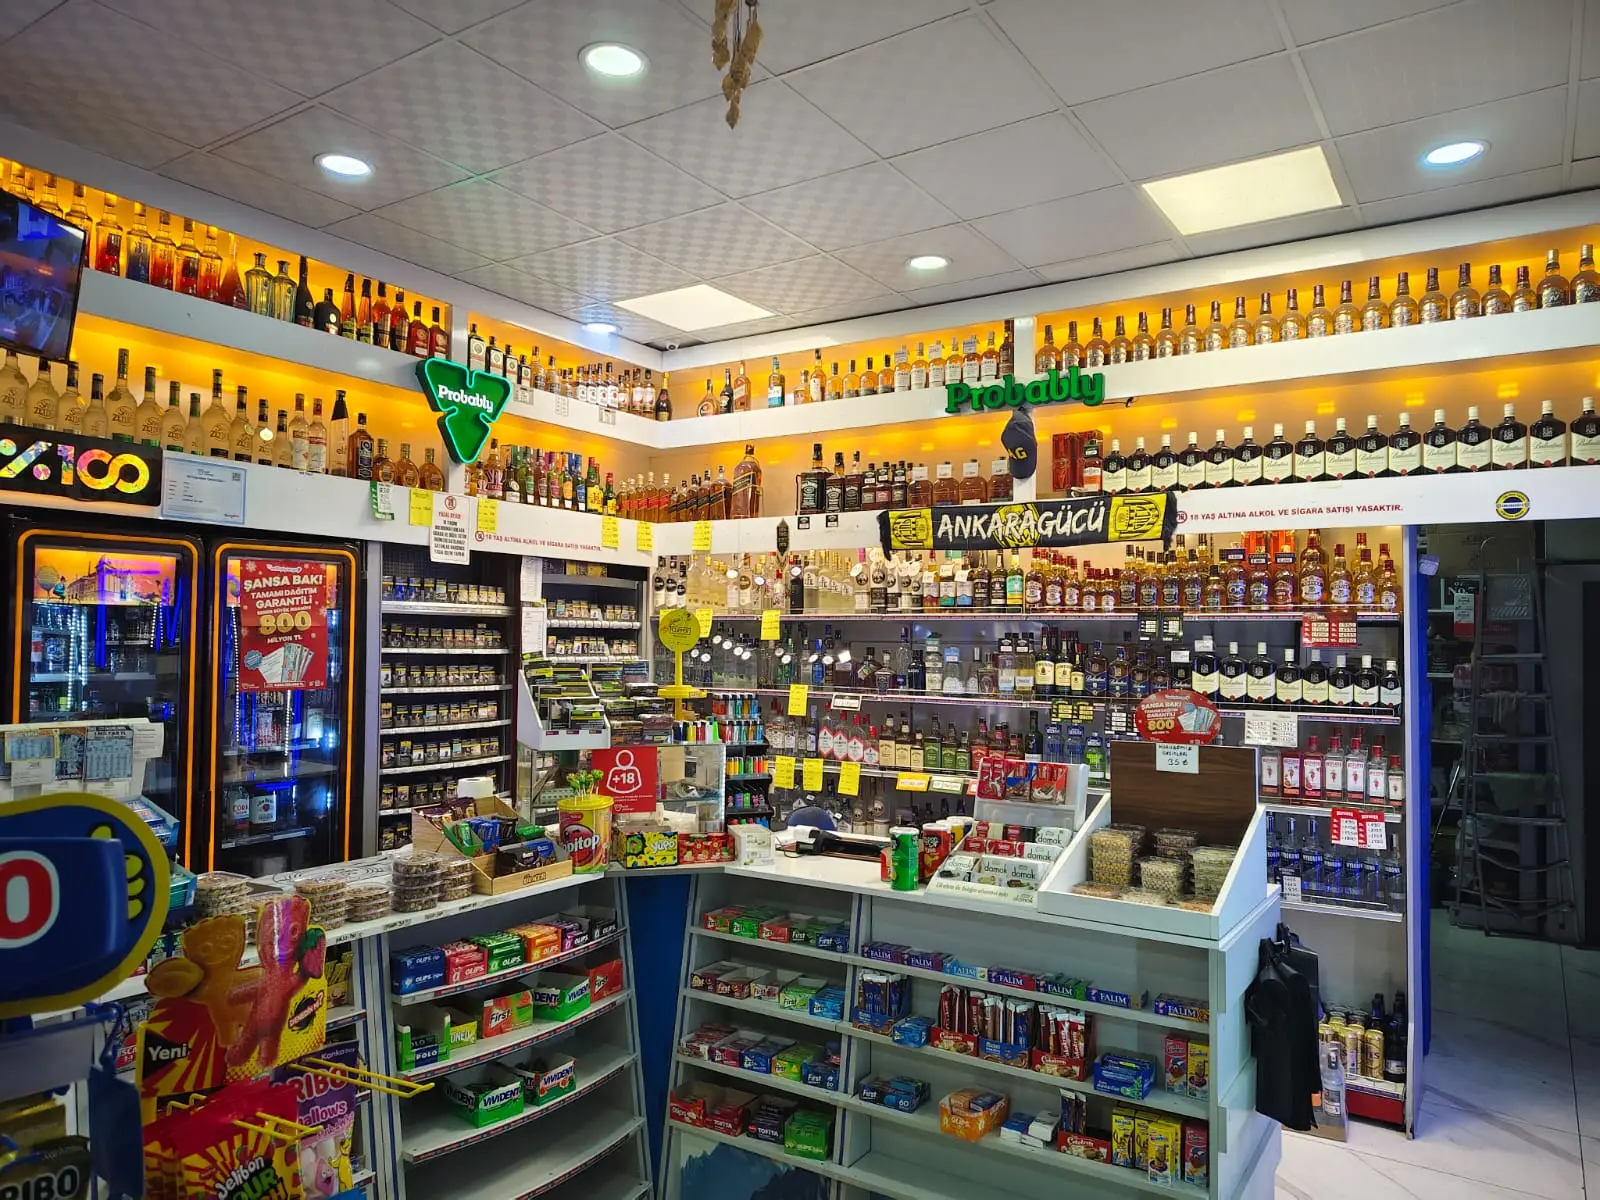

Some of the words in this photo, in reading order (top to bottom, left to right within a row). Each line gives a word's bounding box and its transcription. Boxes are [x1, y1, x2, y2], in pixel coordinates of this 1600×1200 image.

[945, 366, 1104, 413] Probably
[438, 384, 493, 414] Probably
[1218, 511, 1246, 519] ALTINA
[1248, 510, 1275, 518] ALKOL
[1291, 506, 1323, 516] SİGARA
[1325, 505, 1353, 514] SATIŞI
[1356, 504, 1403, 512] YASAKTIR.
[937, 501, 1106, 540] ANKARAGÜCÜ
[244, 575, 291, 592] ŞANSA
[251, 590, 284, 599] TAMAMI
[284, 587, 317, 597] DAĞITIM
[255, 595, 313, 609] GARANTİLİ
[259, 610, 312, 636] 800
[1147, 719, 1175, 731] 800
[612, 772, 636, 785] +18
[984, 862, 1007, 874] damak
[1011, 865, 1035, 880] damak
[818, 937, 833, 946] First
[502, 956, 521, 966] OLIPS
[870, 950, 891, 960] FALIM
[911, 957, 932, 967] FALIM
[999, 974, 1023, 986] FALIM
[1048, 984, 1073, 996] FALIM
[534, 992, 559, 1004] DENT
[1100, 992, 1127, 1005] FALIM
[490, 1008, 511, 1022] First
[1167, 1005, 1197, 1017] FALIM
[148, 1043, 188, 1062] Yeni
[416, 1050, 437, 1060] POLO
[544, 1066, 574, 1086] VIVIDENT
[807, 1073, 822, 1082] First
[483, 1087, 521, 1107] VIVIDENT
[862, 1089, 877, 1098] First
[299, 1101, 348, 1127] allows
[1, 1165, 80, 1200] RIBO
[215, 1156, 265, 1200] Jelibon
